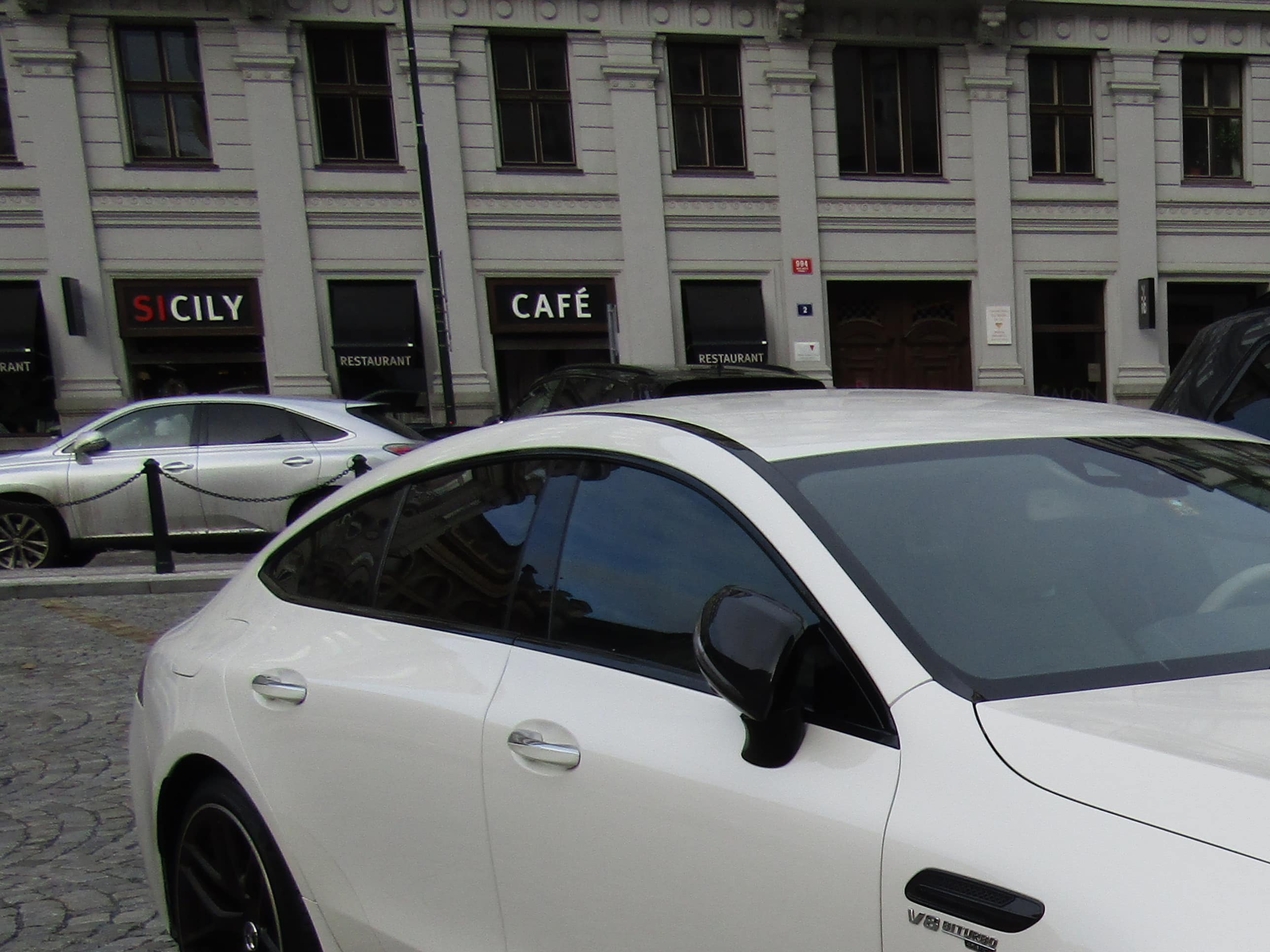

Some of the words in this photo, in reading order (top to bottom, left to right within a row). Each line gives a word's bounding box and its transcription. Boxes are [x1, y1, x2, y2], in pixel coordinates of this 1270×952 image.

[133, 293, 244, 323] SICILY
[511, 286, 592, 320] CAFÉ
[802, 306, 808, 314] 2
[339, 355, 412, 368] RESTAURANT
[698, 352, 764, 365] RESTAURANT
[907, 908, 941, 932] V8
[942, 920, 998, 949] BITURBO
